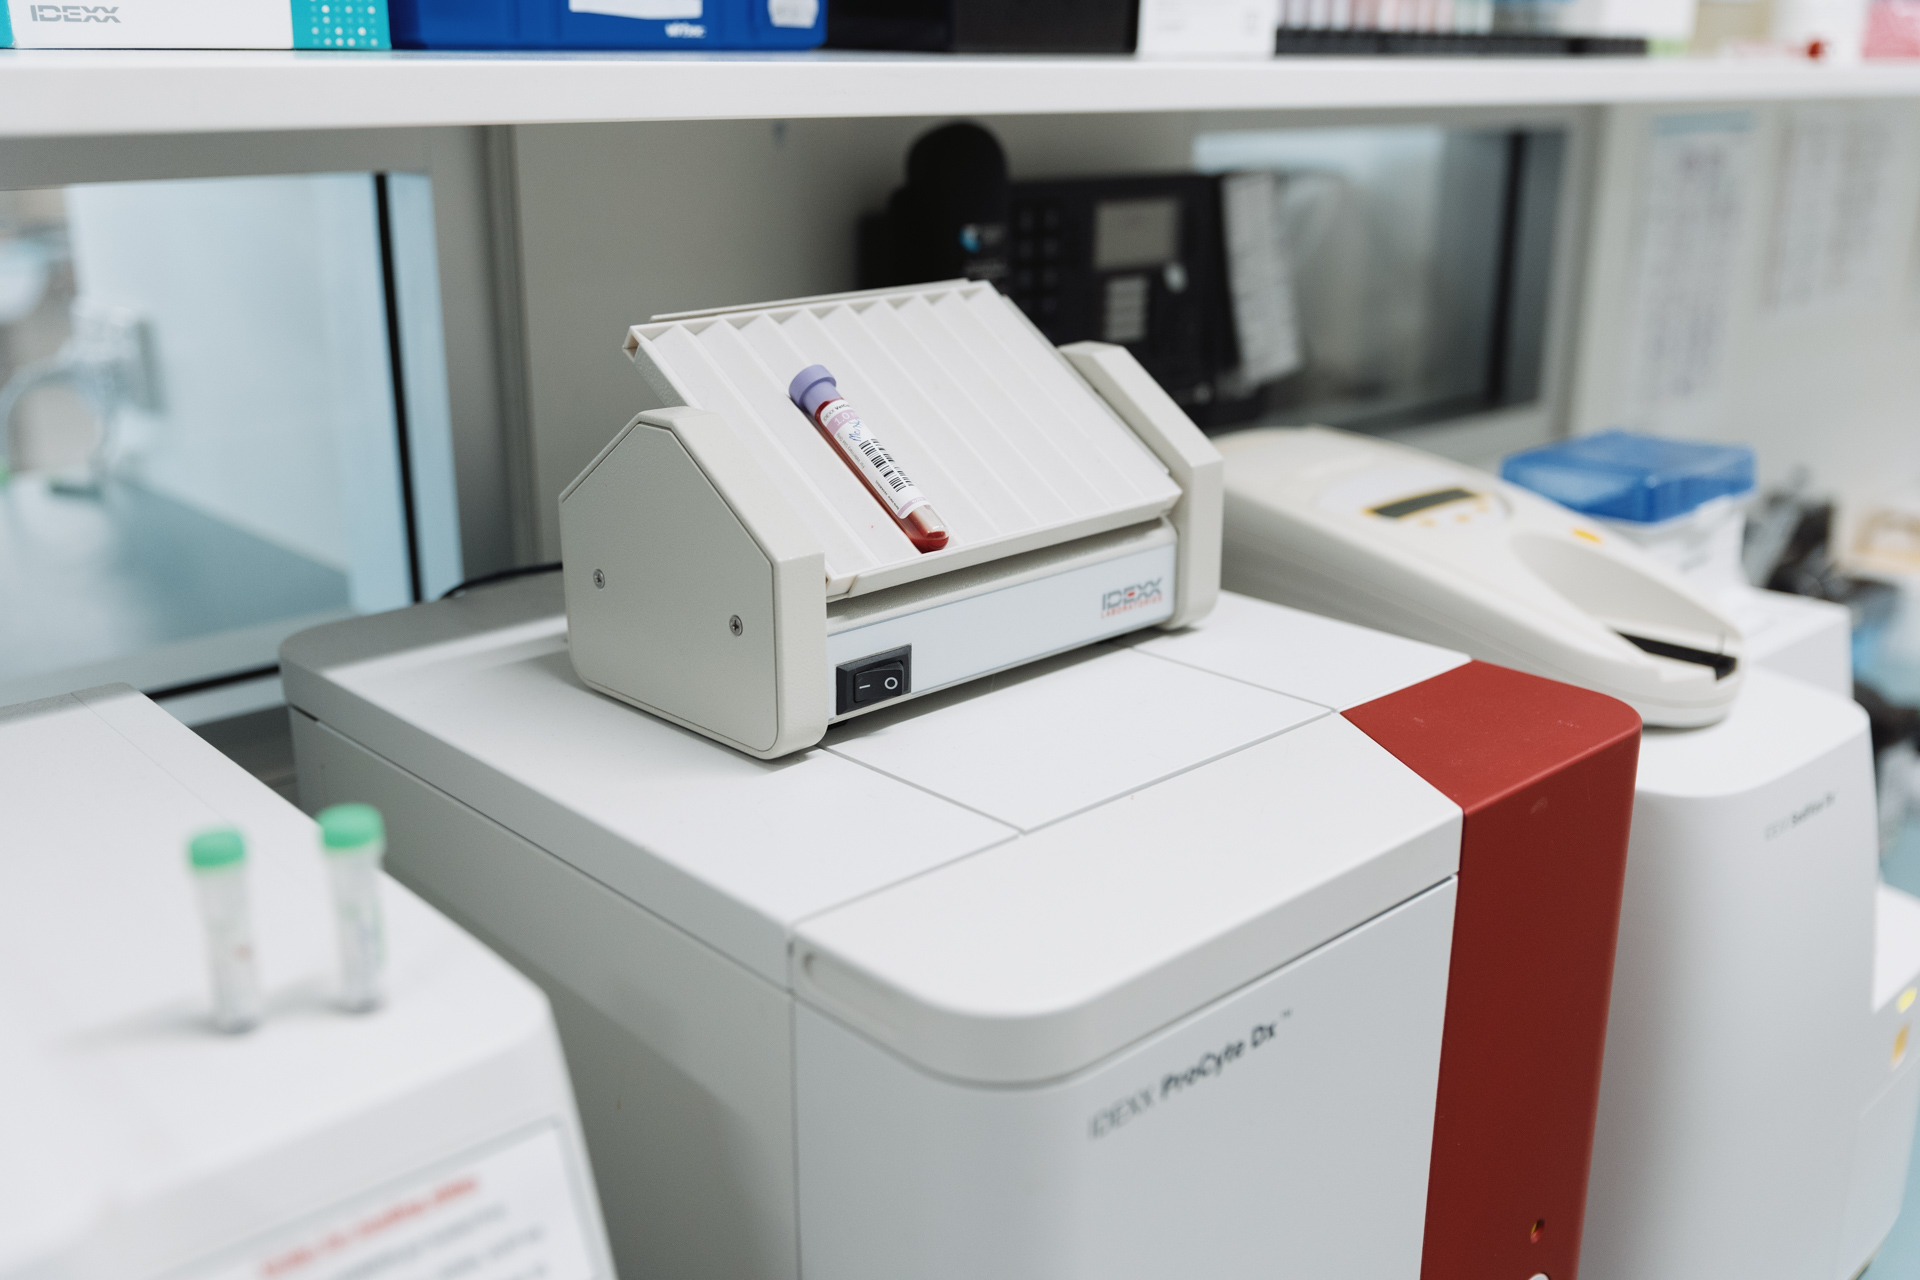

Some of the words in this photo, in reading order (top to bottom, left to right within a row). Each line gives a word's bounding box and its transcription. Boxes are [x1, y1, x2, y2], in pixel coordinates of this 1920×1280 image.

[30, 4, 121, 23] IDEXX
[834, 412, 850, 426] 1.0
[1100, 592, 1163, 620] LABORATORIES
[1102, 576, 1163, 612] IDEXX
[1160, 1040, 1247, 1100] ProCyte
